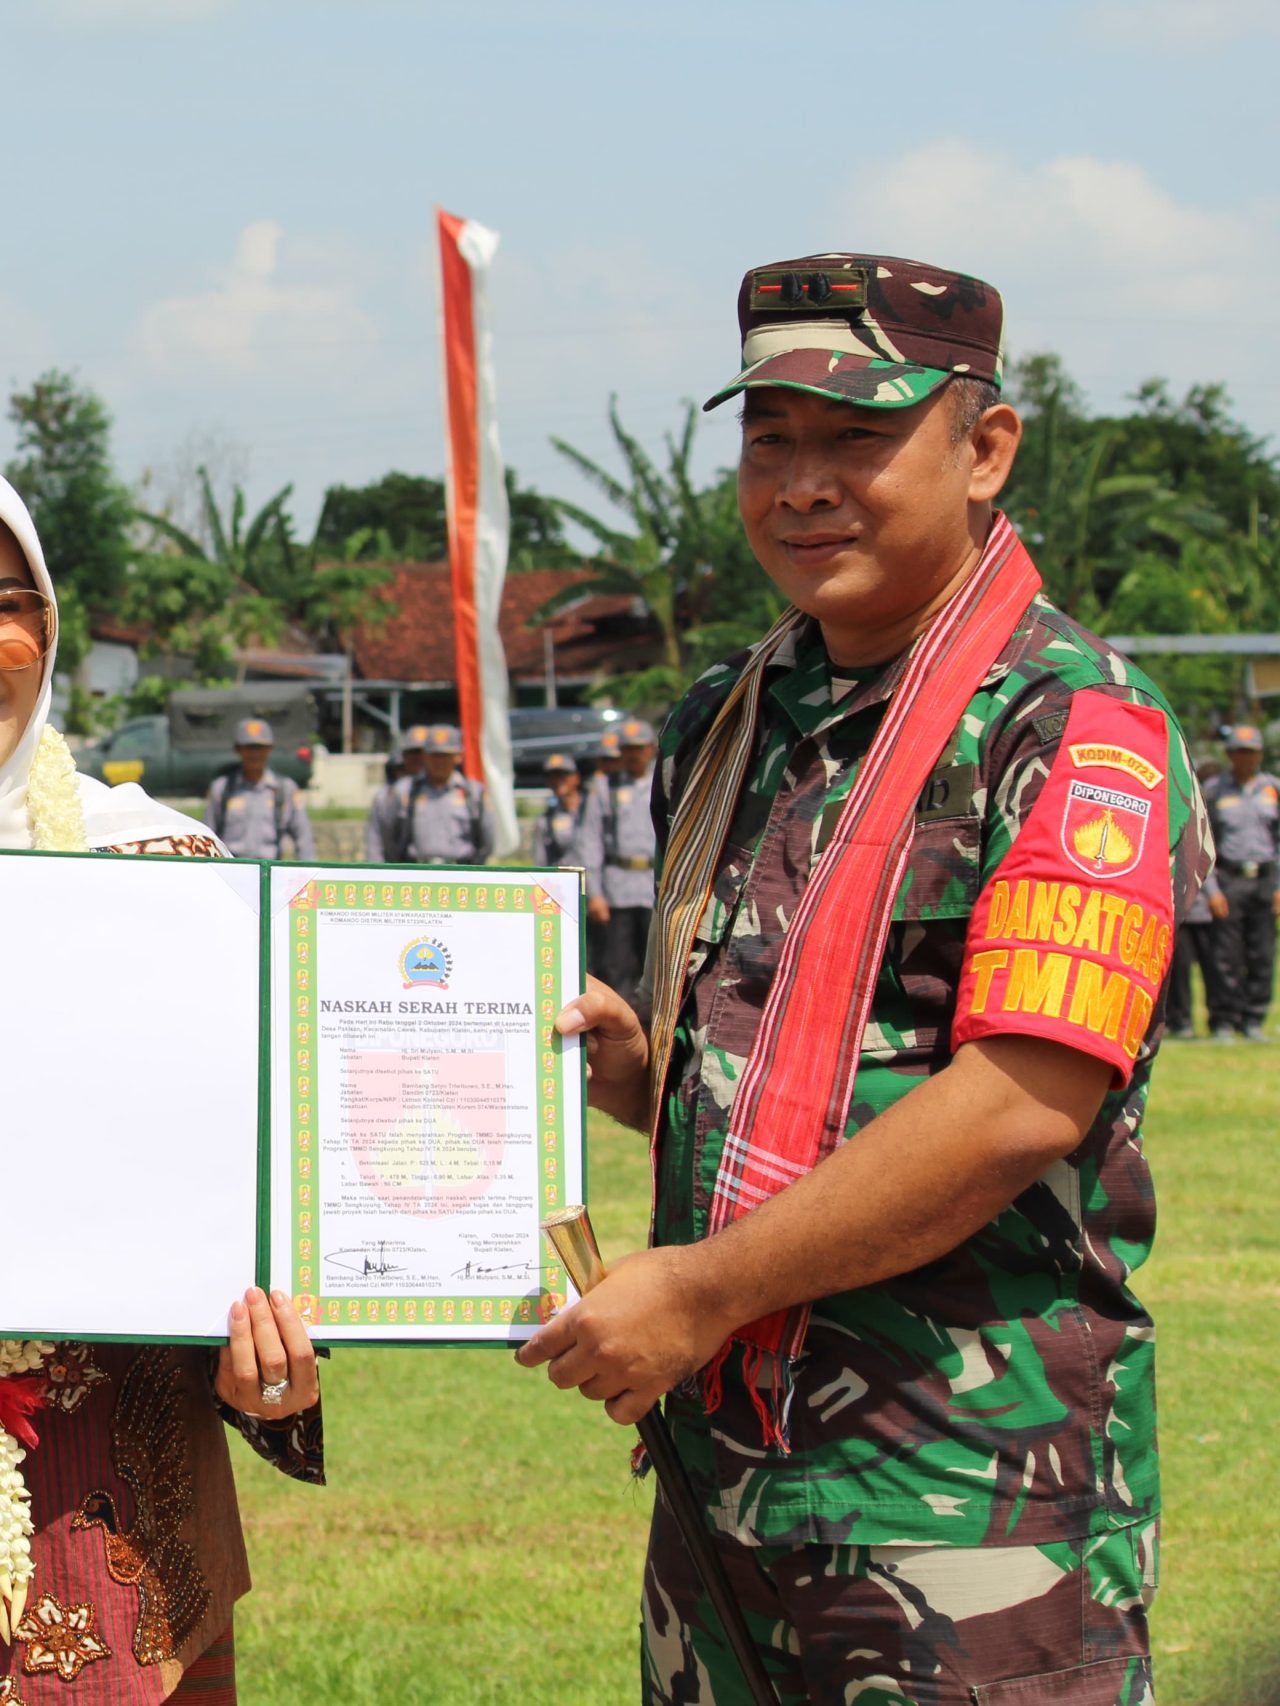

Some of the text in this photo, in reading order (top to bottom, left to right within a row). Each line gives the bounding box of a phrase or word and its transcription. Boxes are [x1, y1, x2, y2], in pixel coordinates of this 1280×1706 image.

[1077, 748, 1157, 783] KODIM-0723
[1072, 783, 1148, 814] DIPONEGORO
[984, 880, 1171, 985] DANSATGAS
[320, 1000, 533, 1015] NASKAH SERAH TERIMA
[969, 948, 1154, 1060] TMMD
